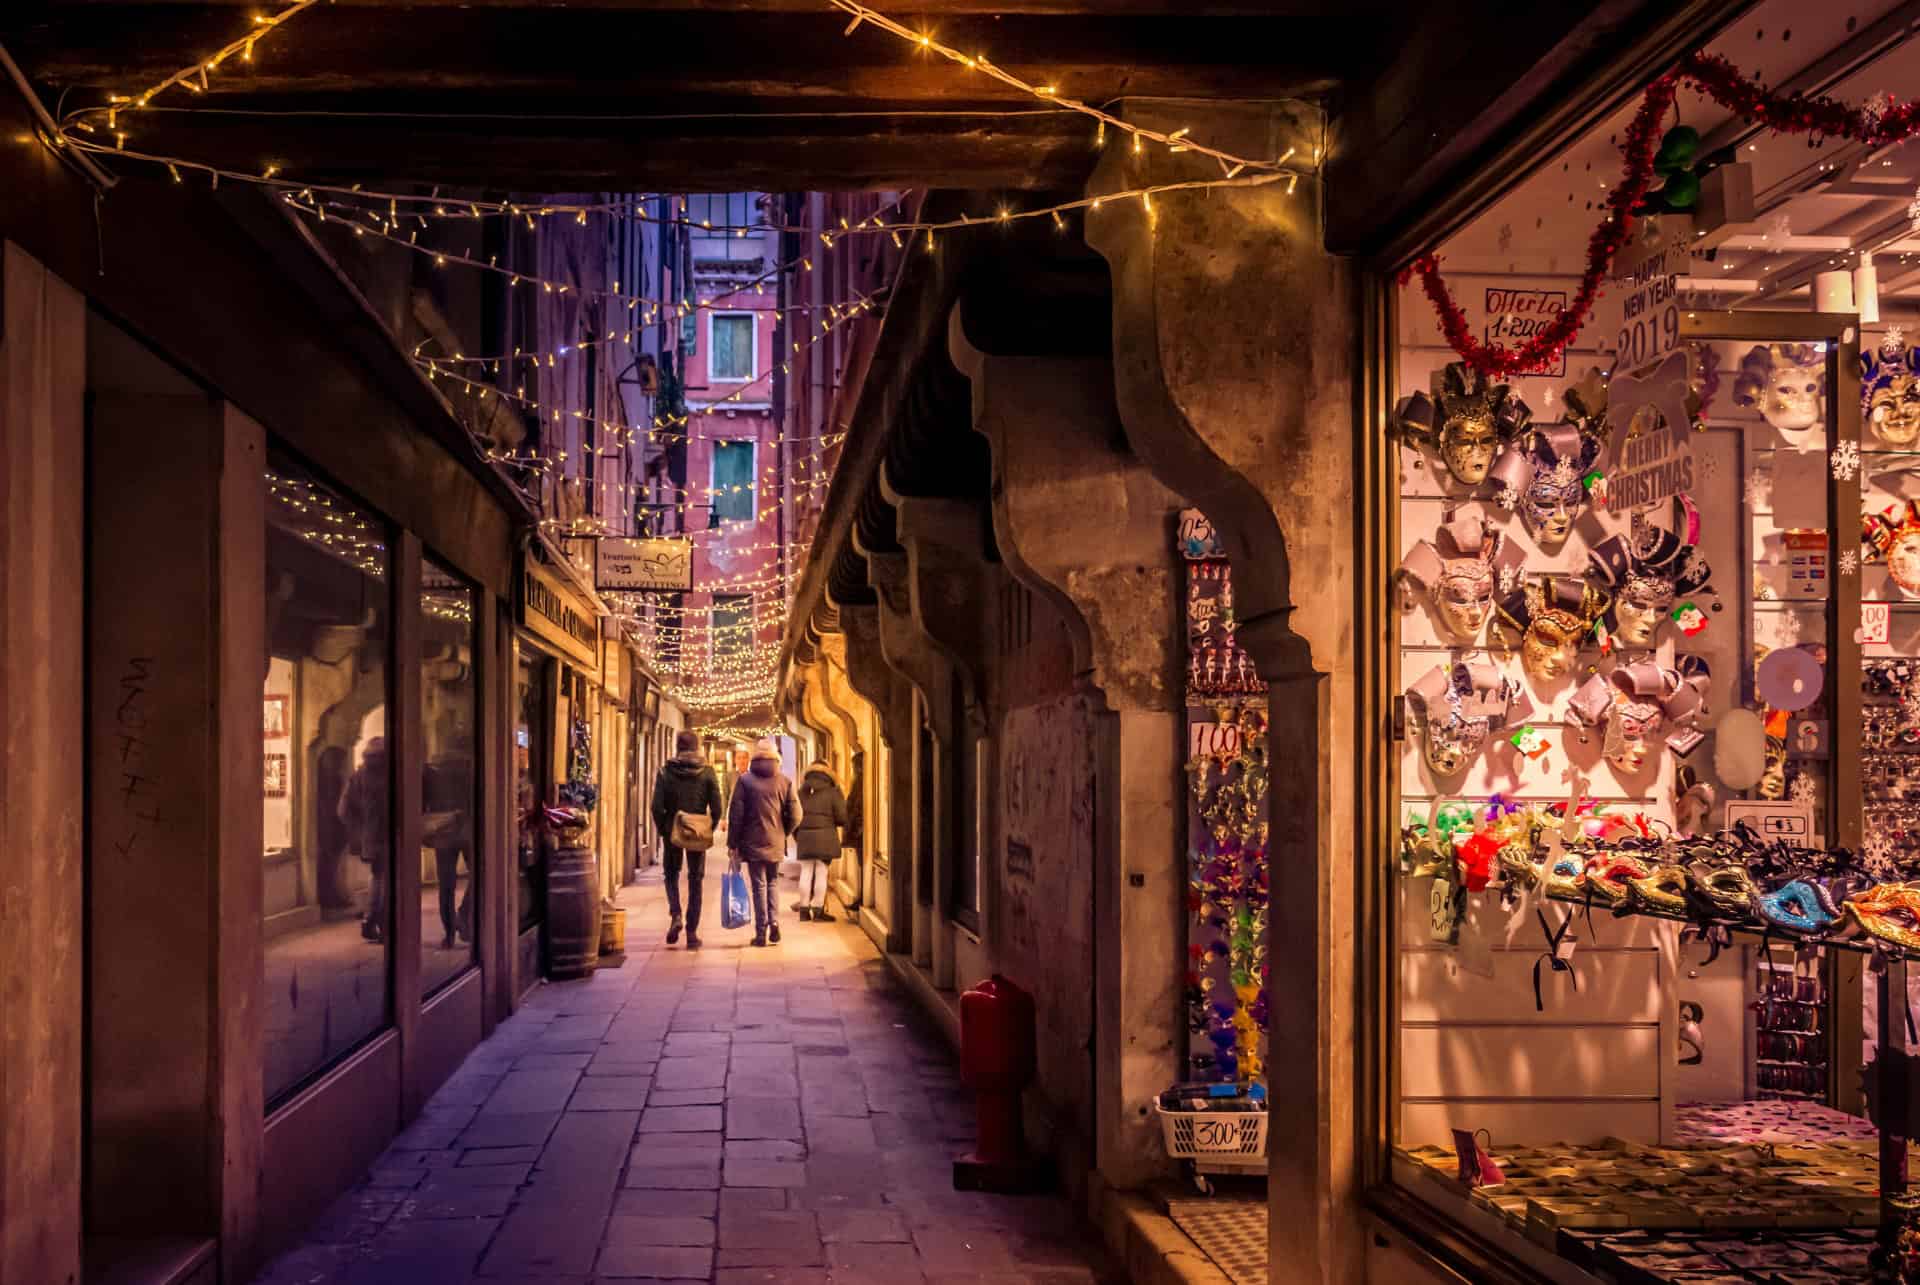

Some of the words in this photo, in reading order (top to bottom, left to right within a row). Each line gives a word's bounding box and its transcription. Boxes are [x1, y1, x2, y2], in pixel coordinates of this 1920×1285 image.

[1633, 249, 1667, 289] HAPPY
[1623, 290, 1646, 321] NEW
[1648, 273, 1677, 309] YEAR
[1617, 304, 1680, 365] 2019
[1627, 430, 1671, 466] MERRY
[1606, 455, 1693, 512] CHRISTMAS
